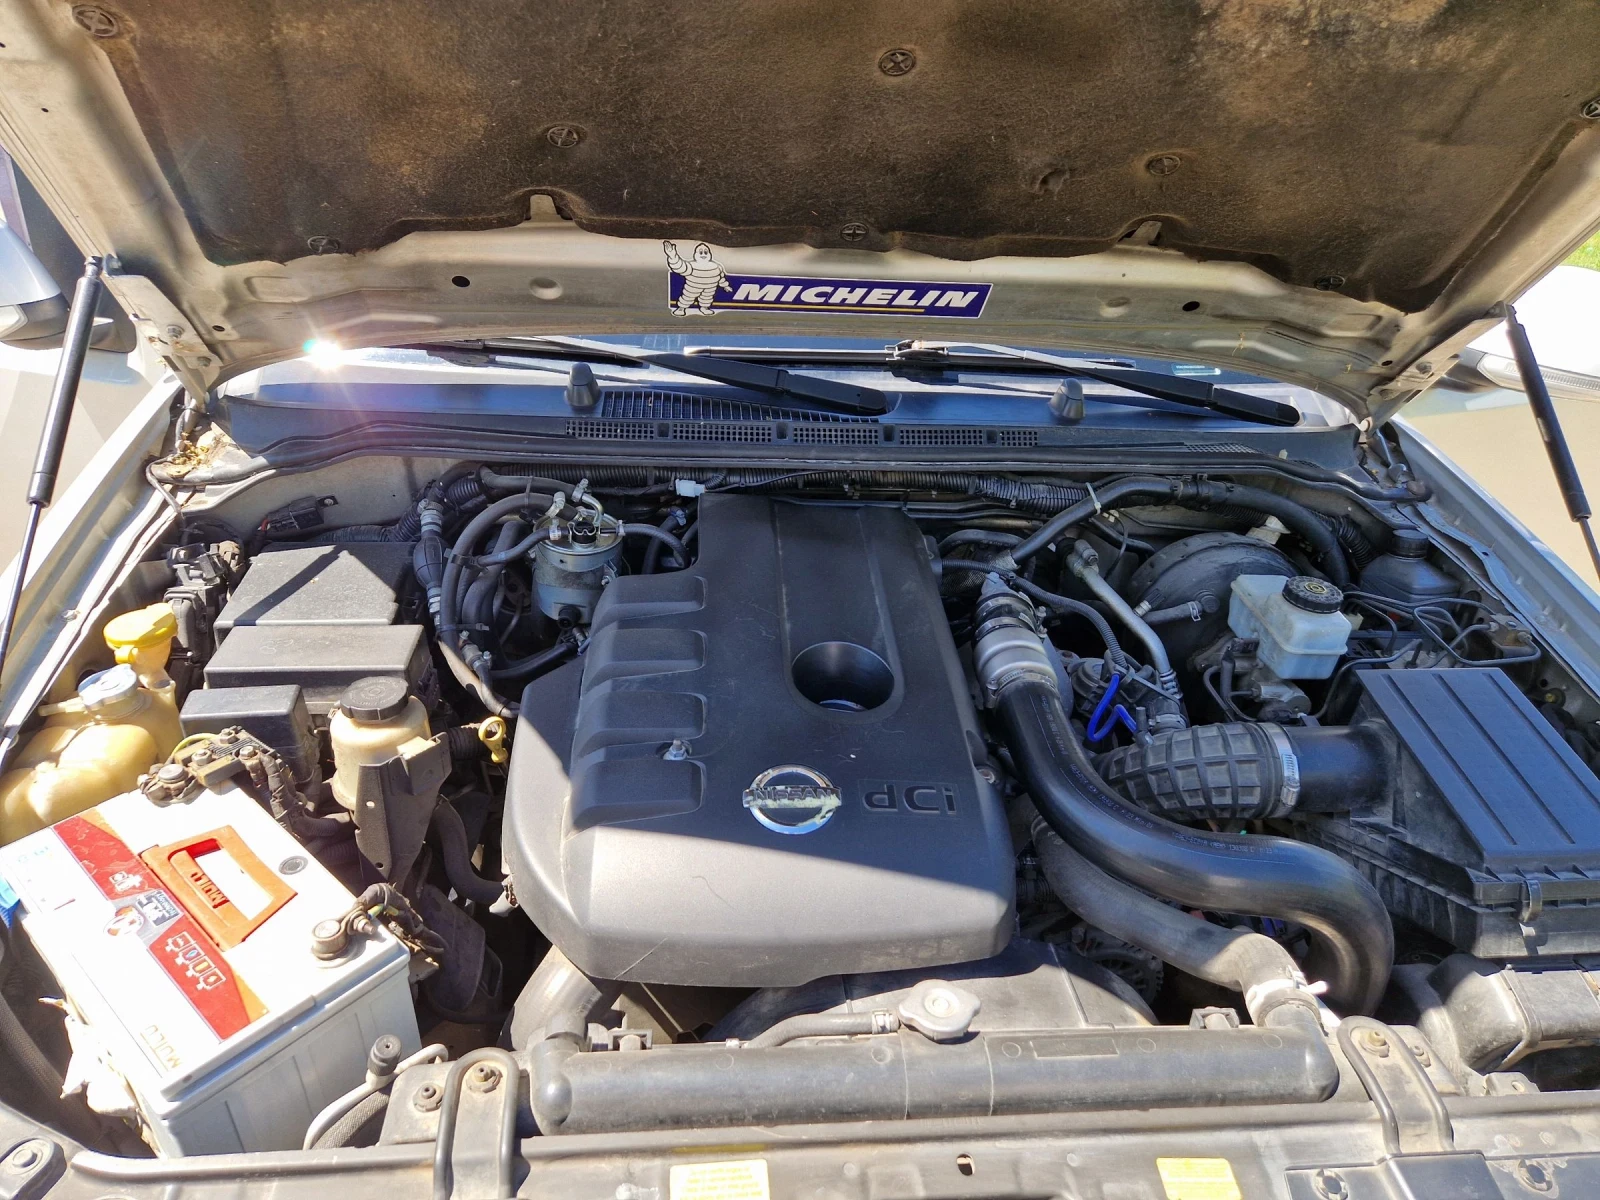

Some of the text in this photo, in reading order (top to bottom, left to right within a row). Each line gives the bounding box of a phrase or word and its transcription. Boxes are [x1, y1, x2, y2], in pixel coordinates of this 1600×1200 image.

[732, 283, 979, 307] MICHELIN
[753, 786, 833, 802] NISSAN
[862, 783, 956, 814] dCi
